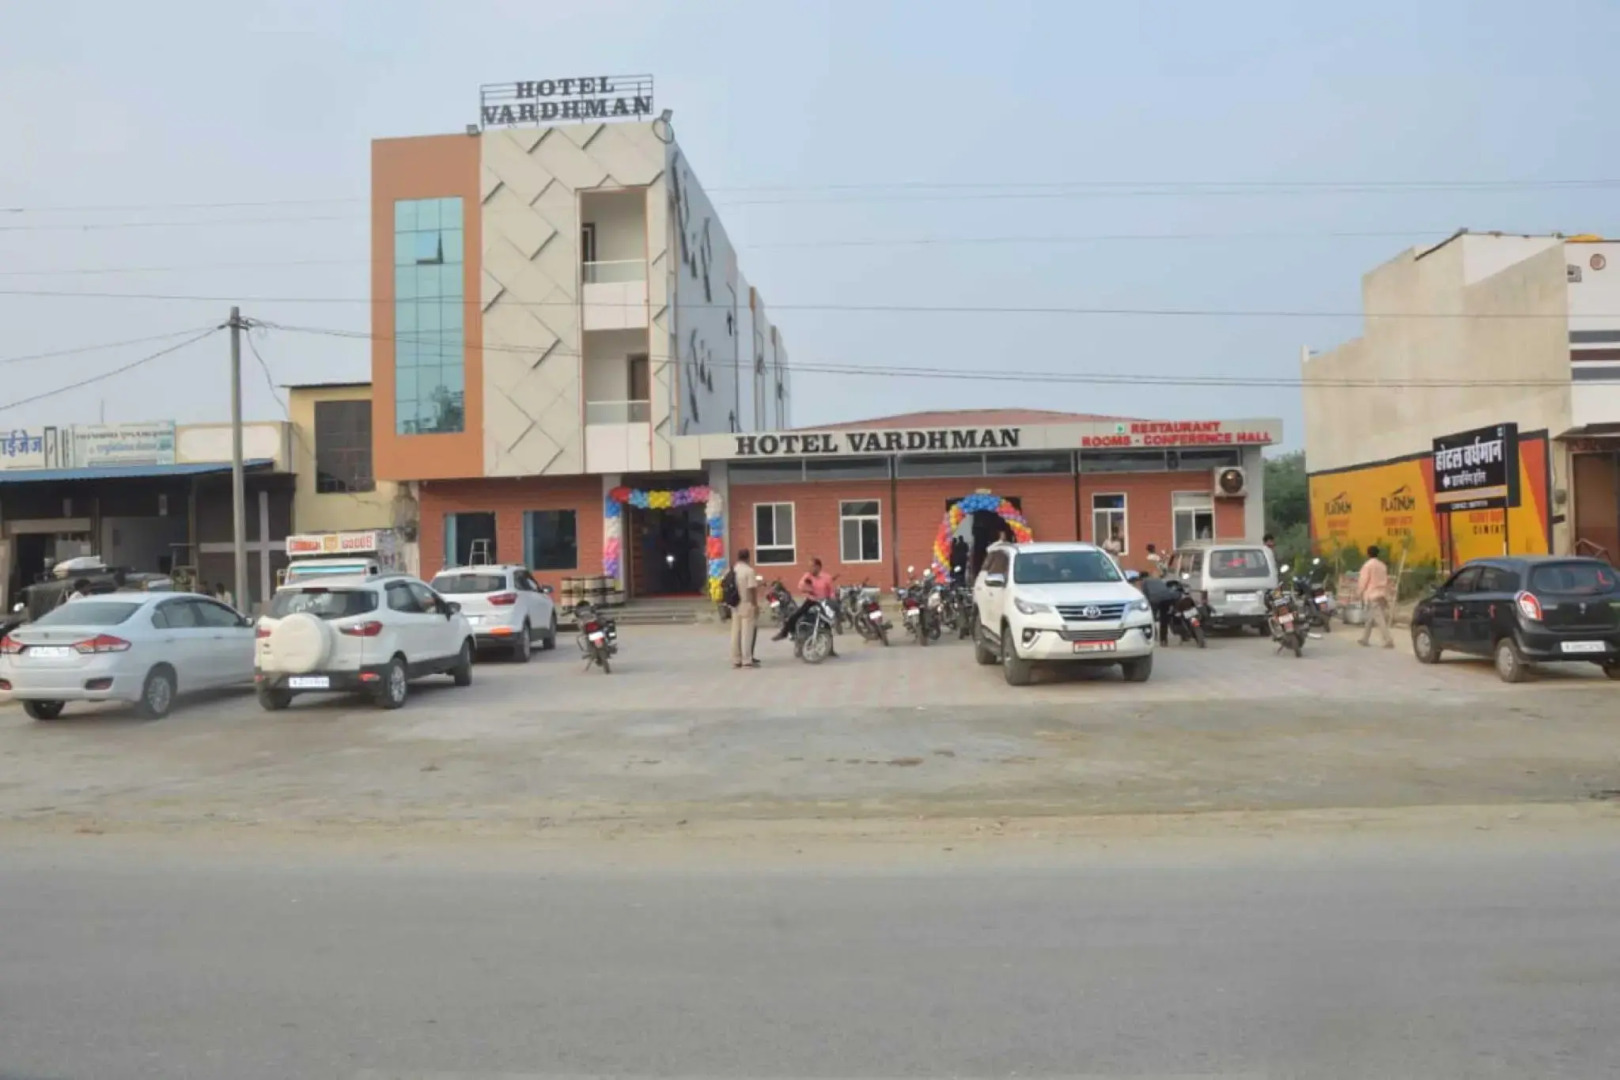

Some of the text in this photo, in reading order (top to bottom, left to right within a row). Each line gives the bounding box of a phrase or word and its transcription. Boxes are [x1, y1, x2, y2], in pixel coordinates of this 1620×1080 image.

[516, 76, 614, 98] HOTEL
[482, 95, 652, 124] VARDHMAN
[1081, 435, 1132, 447] ROOMS
[1143, 433, 1232, 446] CONFERENCE
[1237, 431, 1272, 443] HALL
[1131, 420, 1221, 434] RESTAURANT
[735, 428, 1020, 455] HOTEL VARDHMAN
[1435, 444, 1462, 471] होटल
